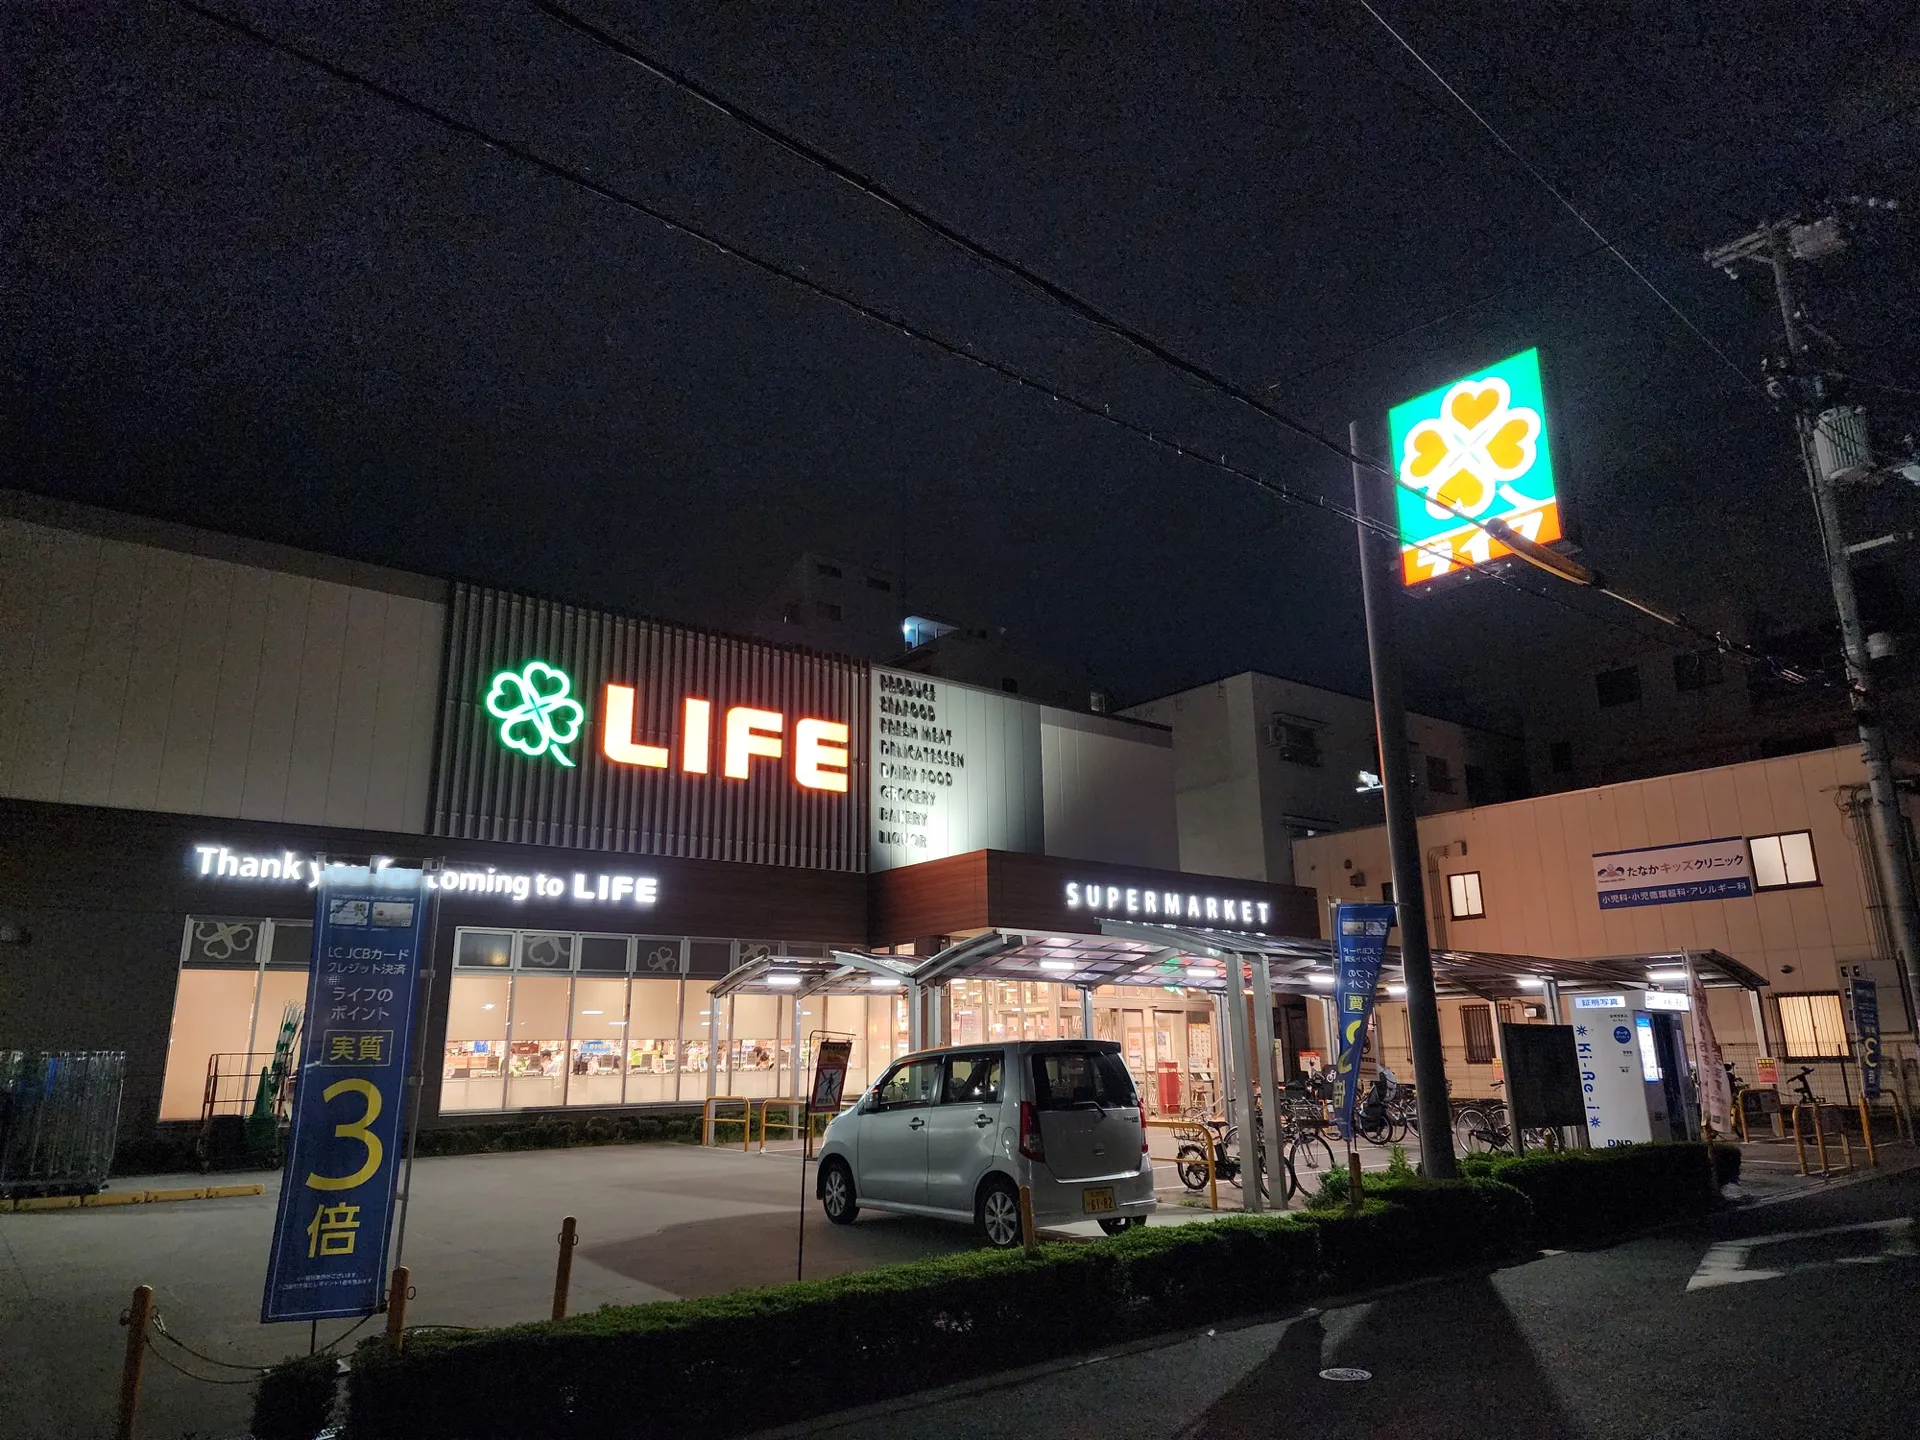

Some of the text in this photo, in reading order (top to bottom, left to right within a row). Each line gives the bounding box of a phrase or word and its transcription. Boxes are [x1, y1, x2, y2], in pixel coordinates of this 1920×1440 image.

[879, 674, 937, 703] PRODUCE
[879, 696, 936, 723] SEAFOOD
[603, 684, 849, 793] LIFE
[879, 717, 953, 747] FRESH MEAT
[879, 739, 965, 769] DELICATESSEN
[880, 761, 954, 788] DAIRY FOOD
[880, 784, 937, 807] GROCERY
[879, 807, 928, 827] BAKERY
[196, 846, 303, 881] Thank
[535, 872, 565, 897] to
[572, 872, 659, 903] LIFE
[1626, 854, 1744, 878] たなかキッズクリニック
[1065, 881, 1271, 925] SUPERMARKET
[327, 962, 408, 976] クレジット決済
[332, 986, 394, 1003] ライフの
[1581, 998, 1619, 1007] 証明写真
[331, 1005, 390, 1021] ポイント
[329, 1035, 384, 1062] 実質
[305, 1078, 383, 1191] 3
[306, 1202, 361, 1259] 倍
